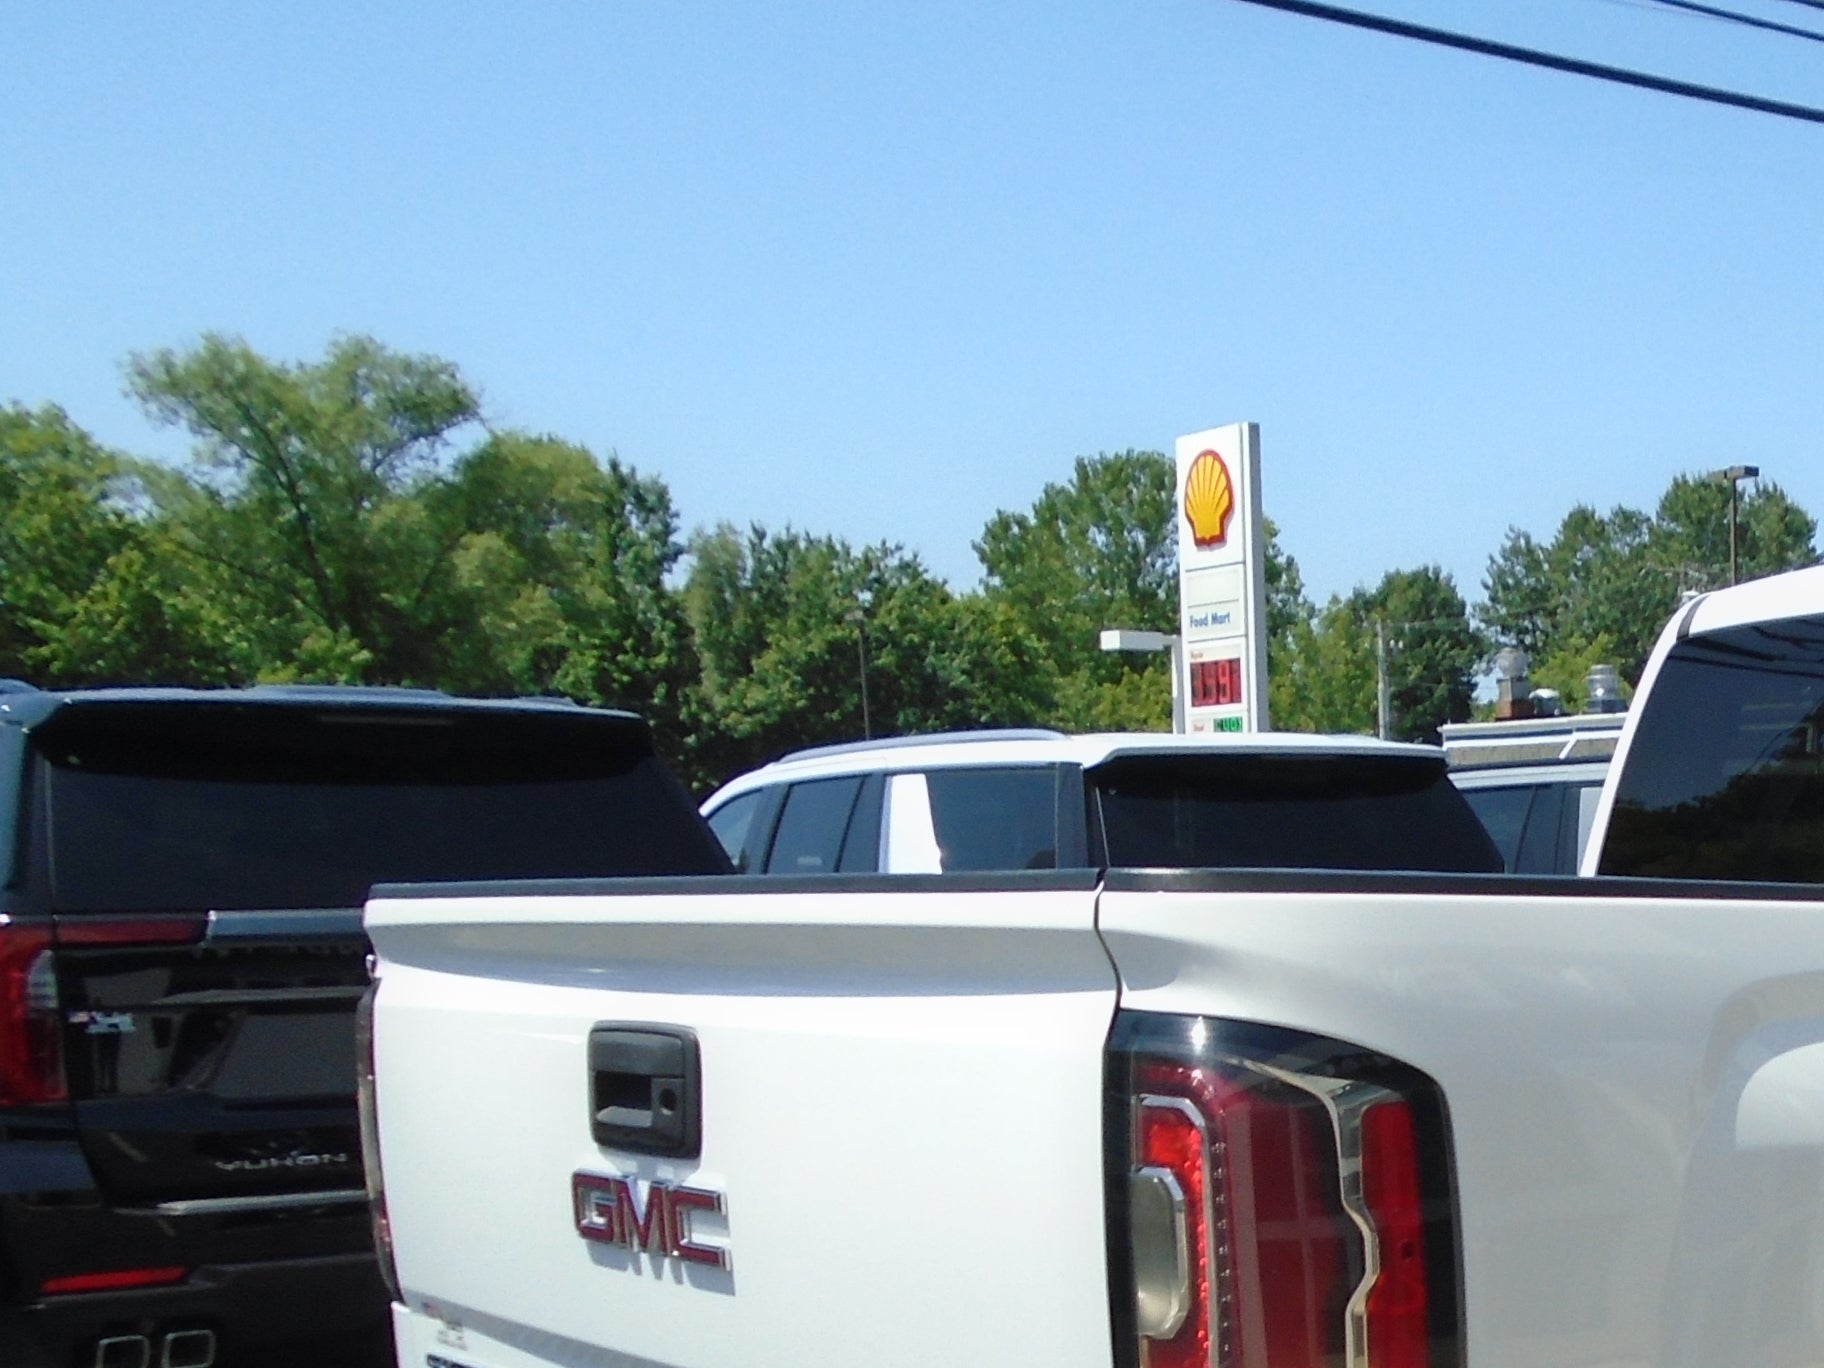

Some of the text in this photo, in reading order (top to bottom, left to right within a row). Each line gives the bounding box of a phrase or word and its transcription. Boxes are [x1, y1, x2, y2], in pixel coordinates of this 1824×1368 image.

[1190, 611, 1231, 628] Food Mart
[571, 1171, 731, 1271] GMC
